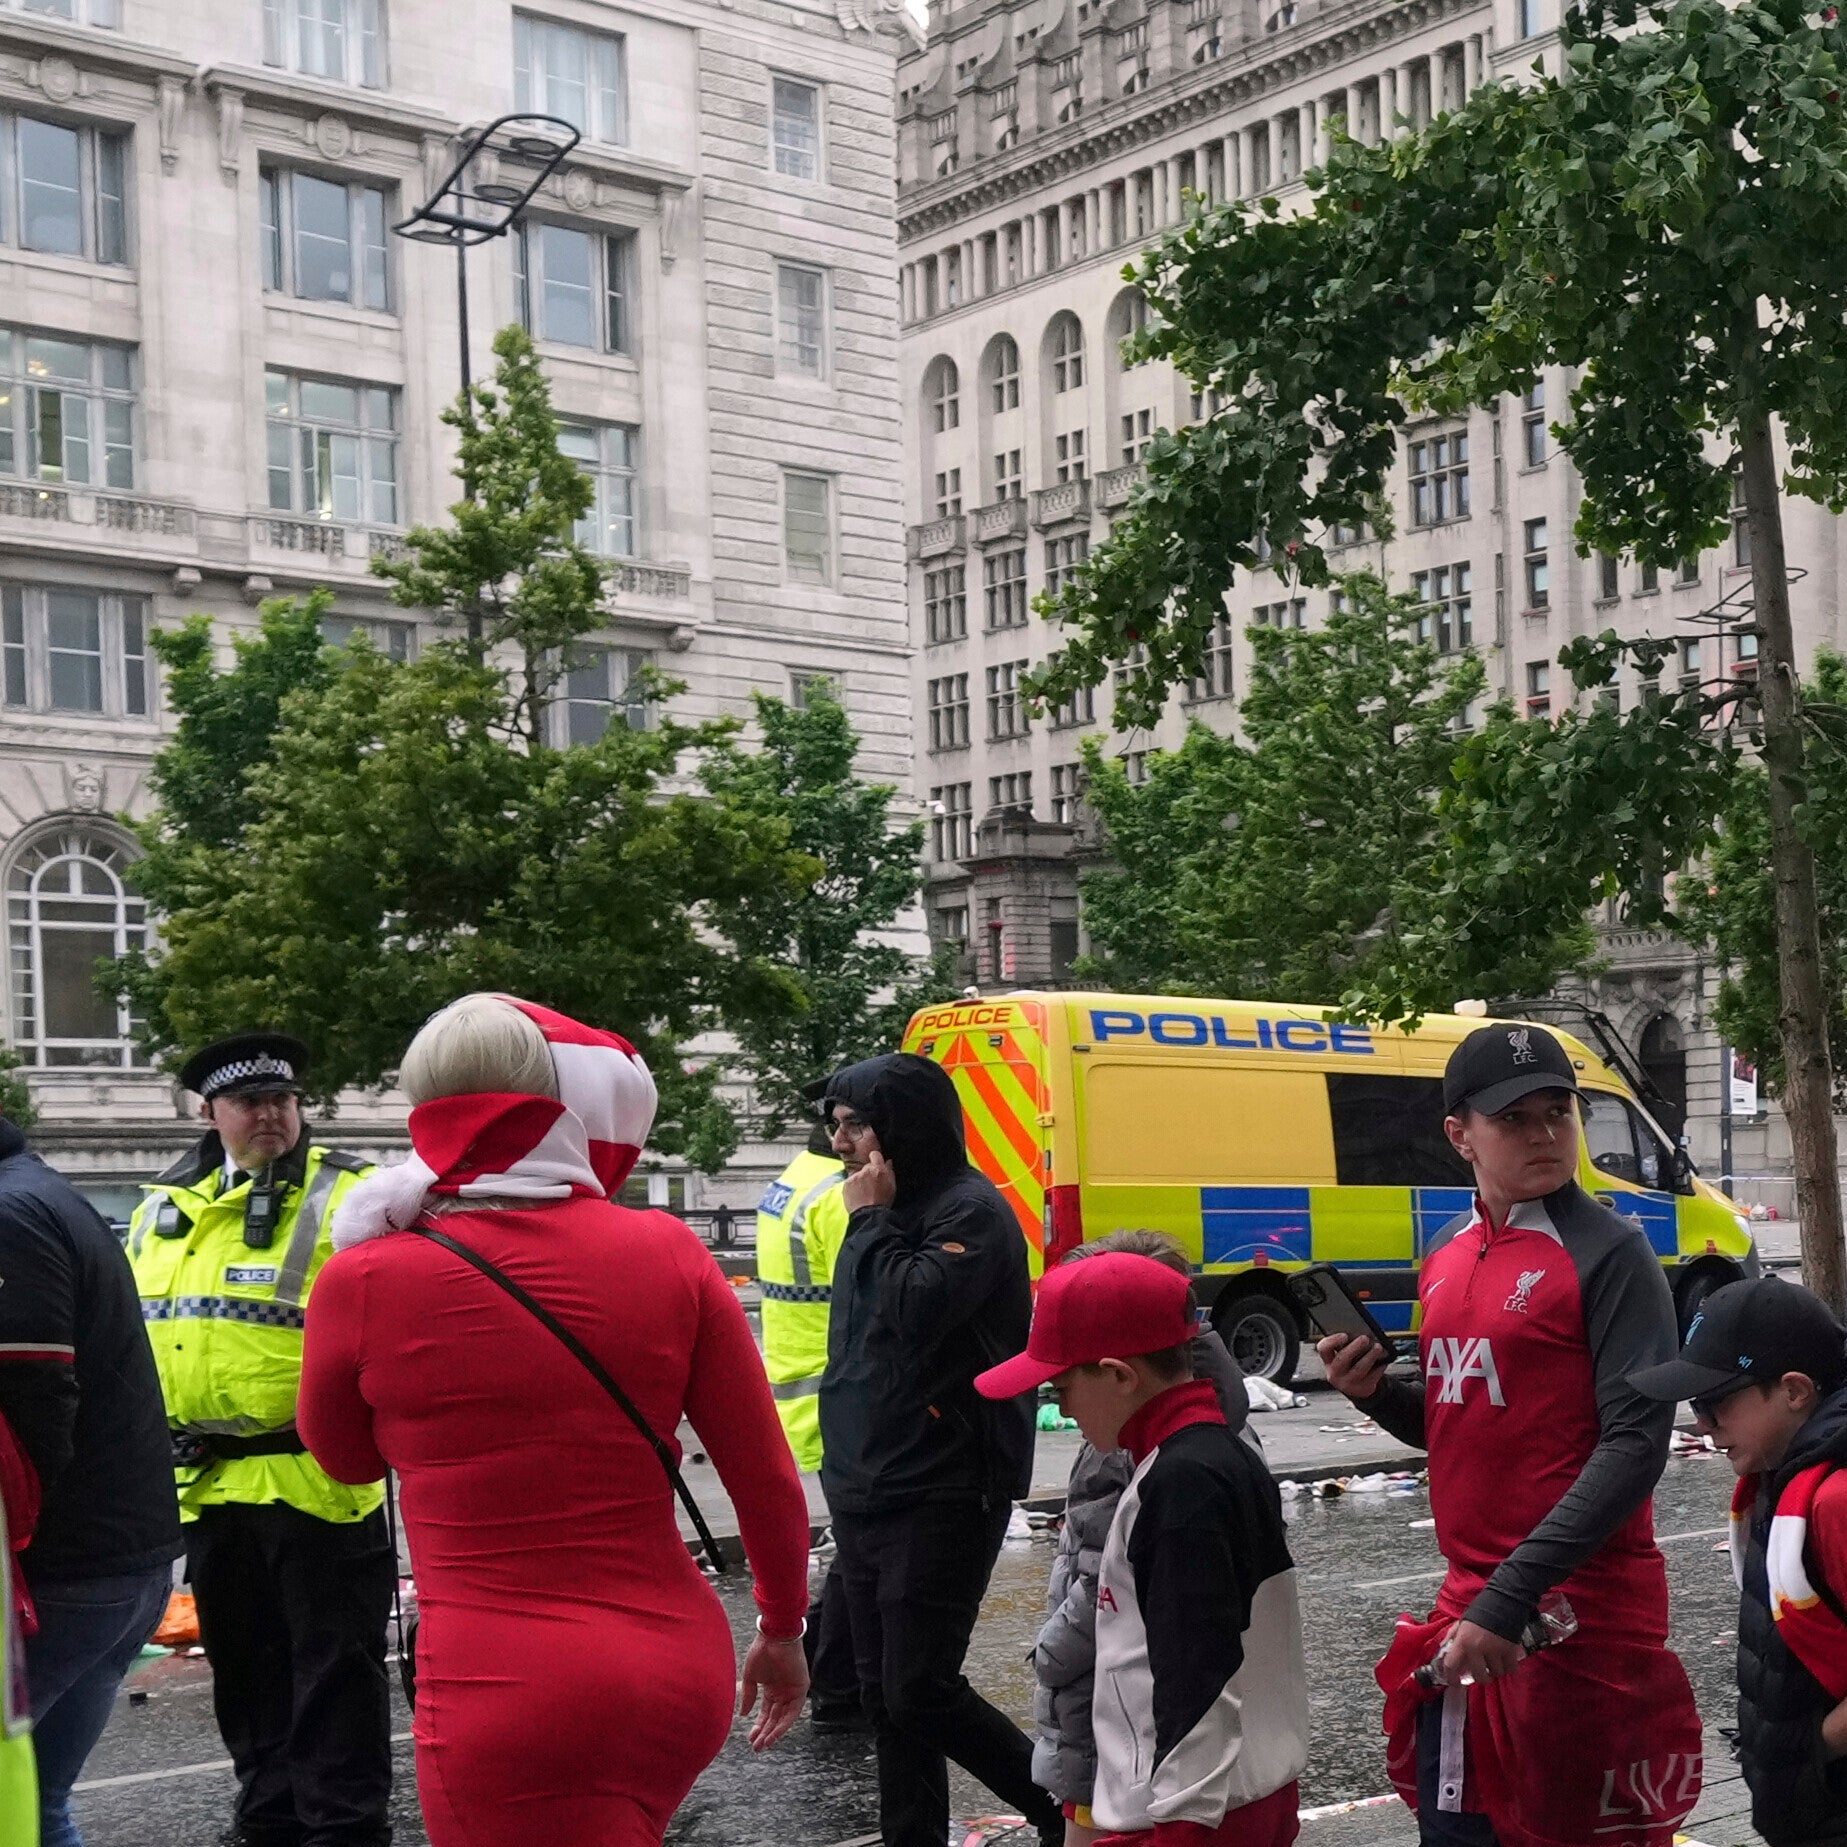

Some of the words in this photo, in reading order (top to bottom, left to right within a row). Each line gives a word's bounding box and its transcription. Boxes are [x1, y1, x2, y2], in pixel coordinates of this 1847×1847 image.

[921, 1007, 1012, 1032] POLICE
[1089, 1010, 1375, 1054] POLICE
[228, 1269, 273, 1281] POLICE
[1426, 1337, 1507, 1407] AXA
